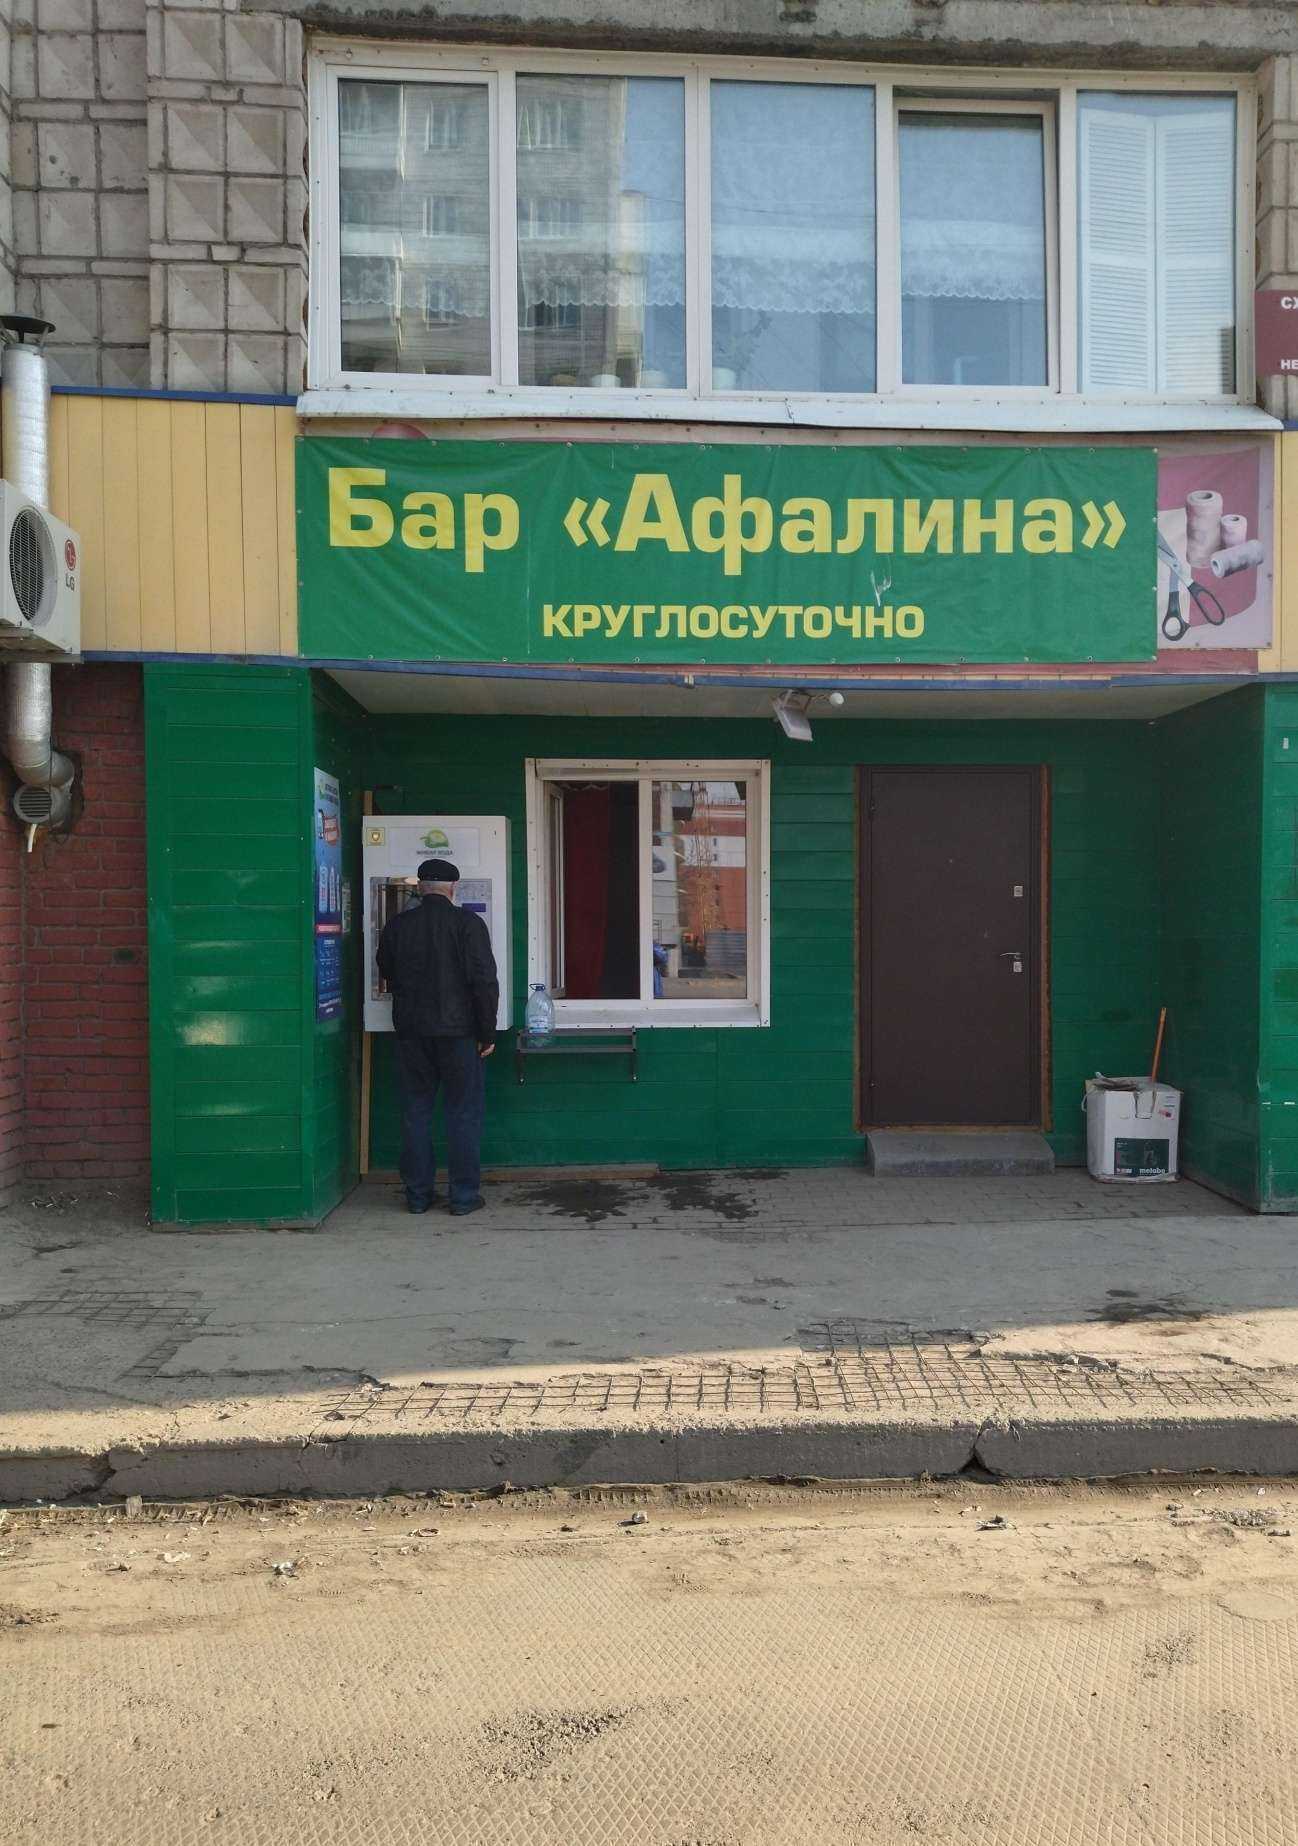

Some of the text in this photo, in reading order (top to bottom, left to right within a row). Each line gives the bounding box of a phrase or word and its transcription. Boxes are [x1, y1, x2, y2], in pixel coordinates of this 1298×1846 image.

[328, 467, 1127, 576] Бар «Афалина»
[65, 572, 75, 591] LG
[543, 604, 925, 639] КРУГЛОСУТОЧНО
